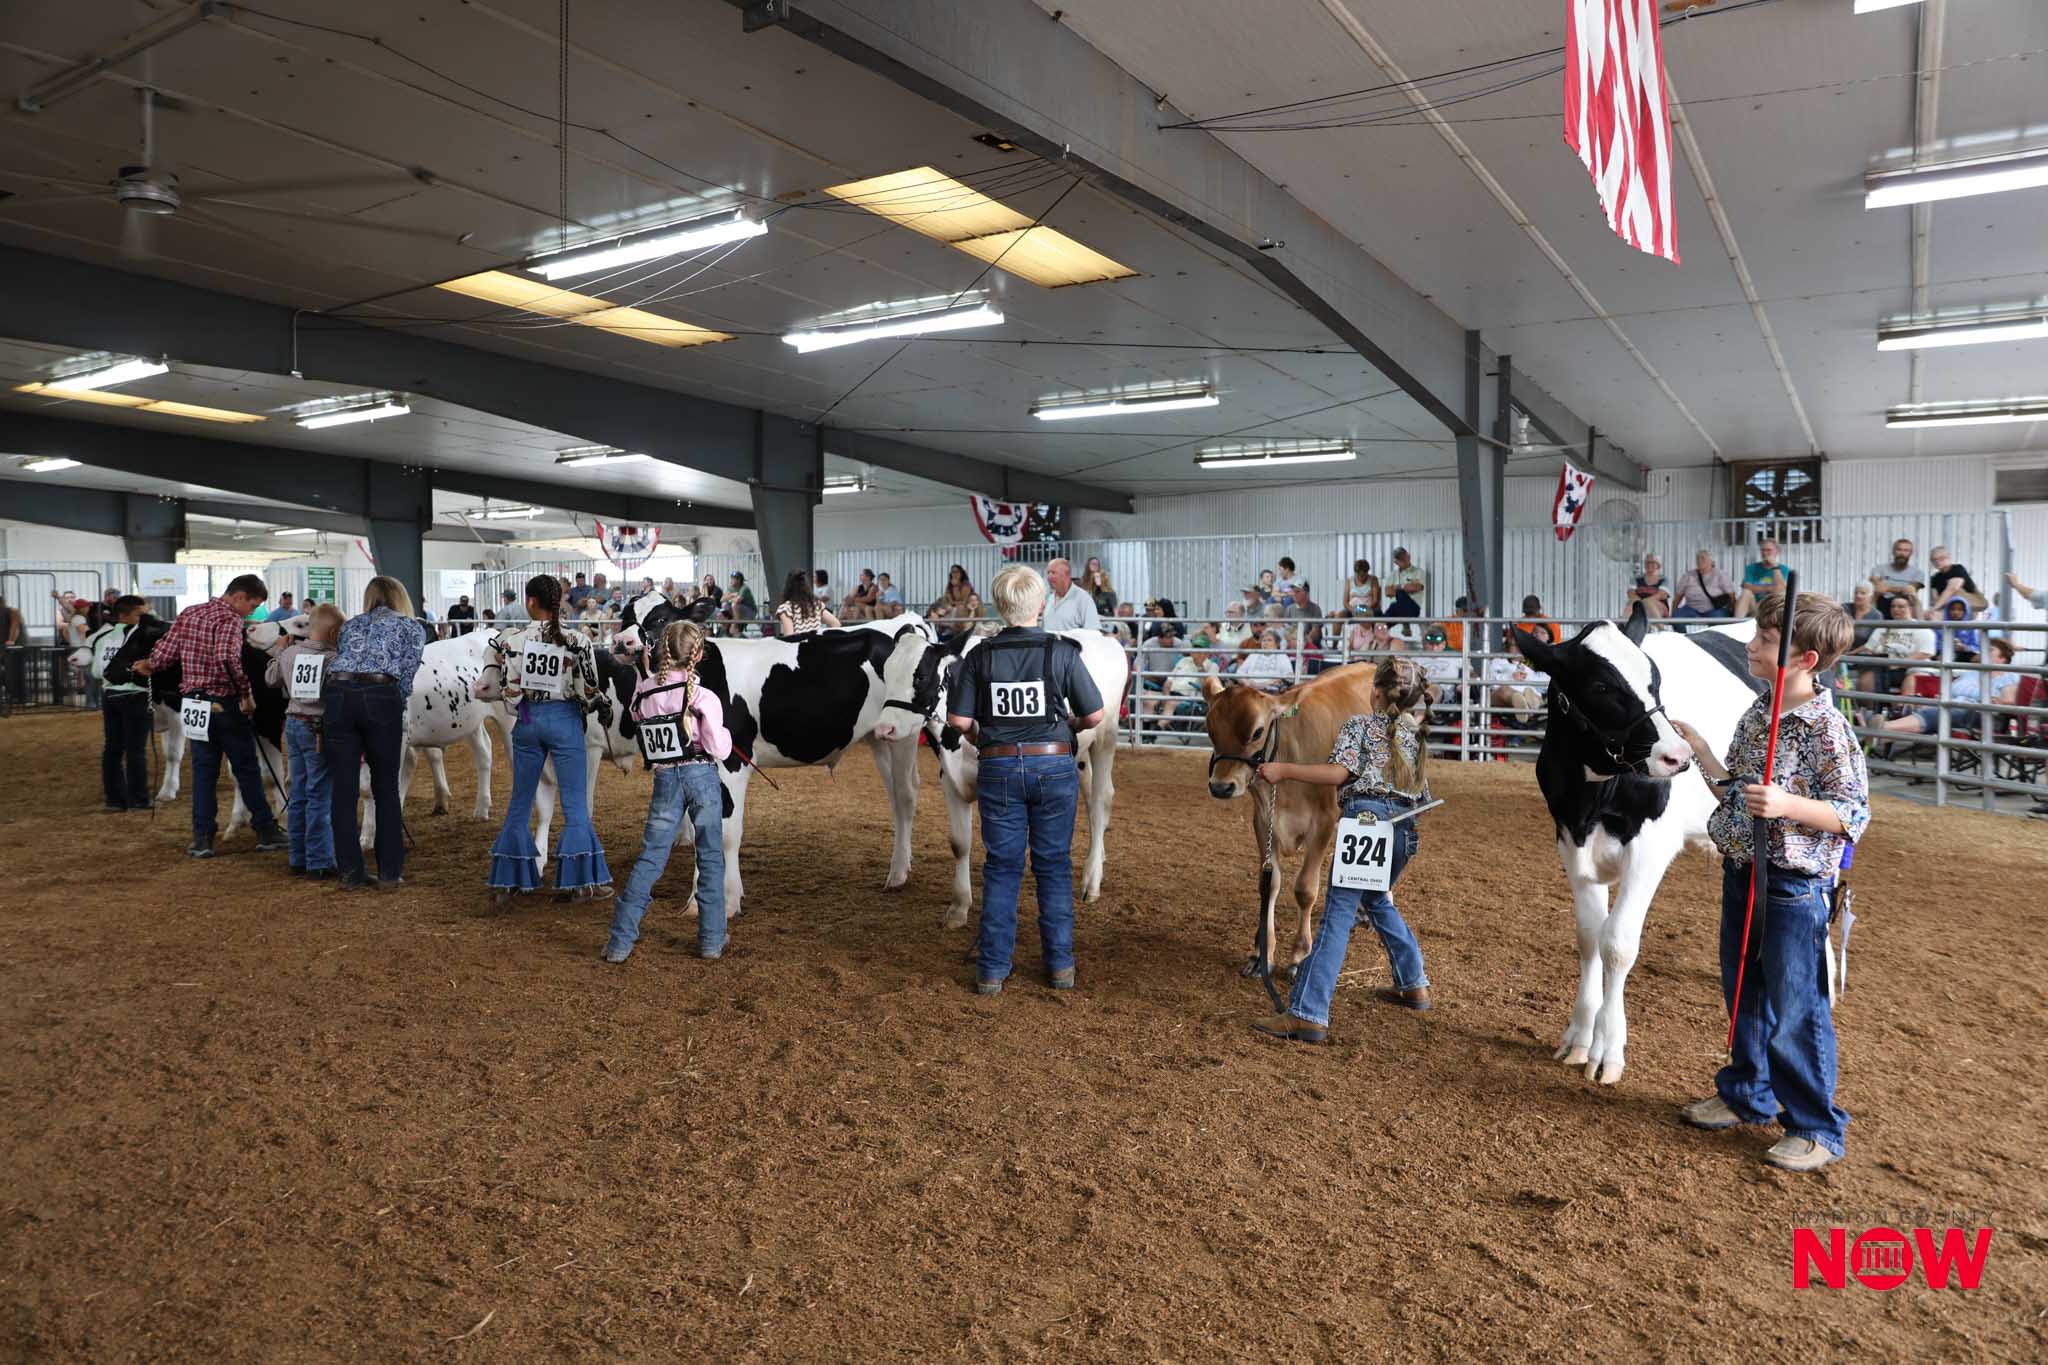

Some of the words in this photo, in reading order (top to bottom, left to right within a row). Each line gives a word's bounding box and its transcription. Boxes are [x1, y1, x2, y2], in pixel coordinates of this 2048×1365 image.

[295, 663, 318, 684] 331
[525, 652, 559, 677] 339
[996, 686, 1040, 716] 303
[183, 707, 207, 729] 335
[644, 726, 676, 754] 342
[1341, 834, 1387, 867] 324
